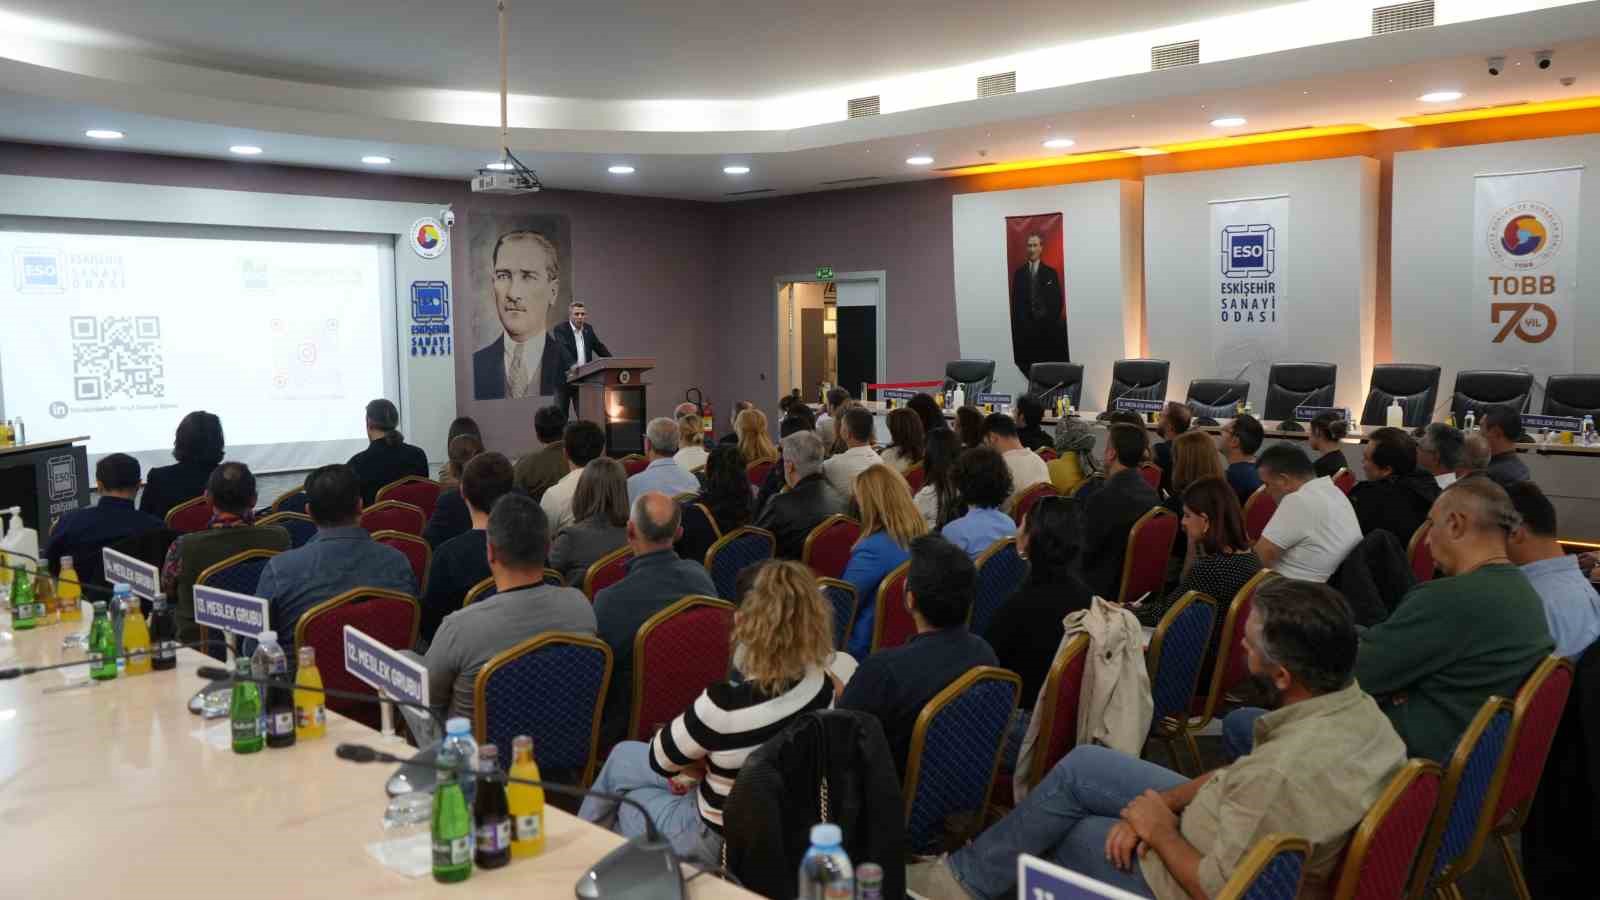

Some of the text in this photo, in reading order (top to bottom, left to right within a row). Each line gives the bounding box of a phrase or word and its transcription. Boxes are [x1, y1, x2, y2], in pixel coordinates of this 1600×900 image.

[1233, 245, 1262, 258] ESO
[1221, 280, 1275, 296] ESKİŞEHİR
[1489, 275, 1555, 295] TOBB
[1221, 296, 1275, 310] SANAYİ
[1221, 311, 1275, 322] ODASI
[1490, 303, 1557, 343] 70
[206, 601, 237, 621] MESLEK
[236, 606, 262, 627] GRUBU
[347, 641, 420, 700] 12. MESLEK GRUBU
